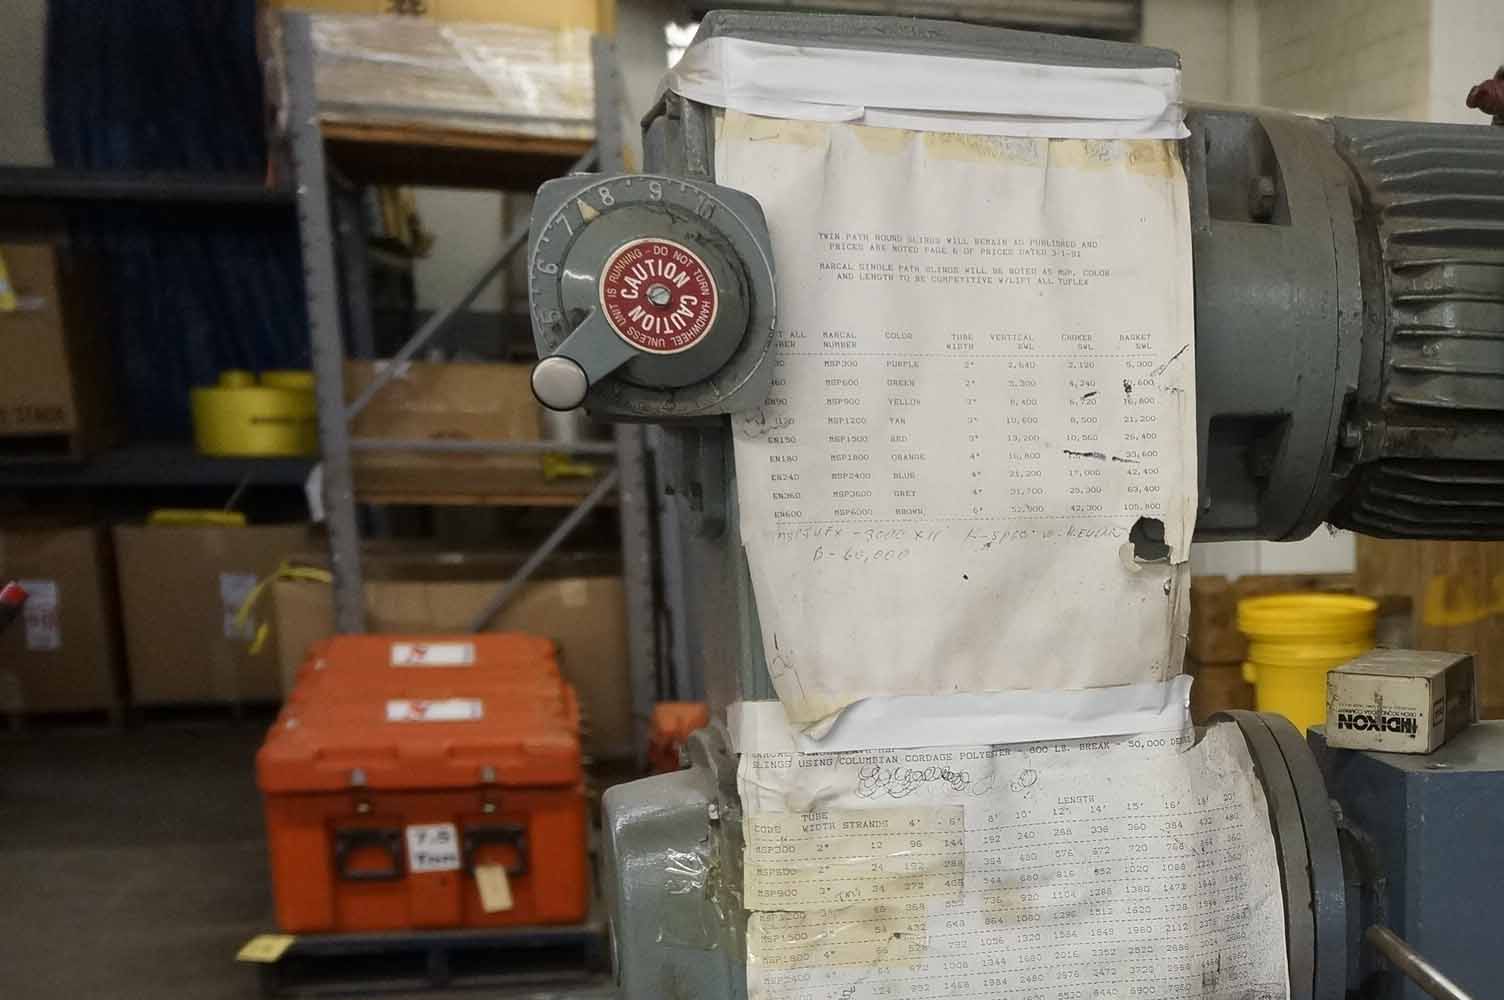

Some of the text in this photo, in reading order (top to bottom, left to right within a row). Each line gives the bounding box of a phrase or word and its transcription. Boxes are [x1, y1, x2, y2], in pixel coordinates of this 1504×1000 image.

[599, 188, 615, 206] 8
[648, 182, 663, 200] 9
[556, 214, 574, 236] 7
[538, 259, 559, 275] 6
[620, 258, 690, 300] CAUTION
[606, 245, 711, 348] DO NOT TURN HANDWHEEL UNLESS UNIT IS RUNNING
[628, 294, 698, 335] CAUTION
[798, 758, 833, 768] USING
[838, 755, 899, 766] COLUMBIAN
[904, 753, 953, 762] CORDAGE
[1079, 741, 1111, 751] BREAK
